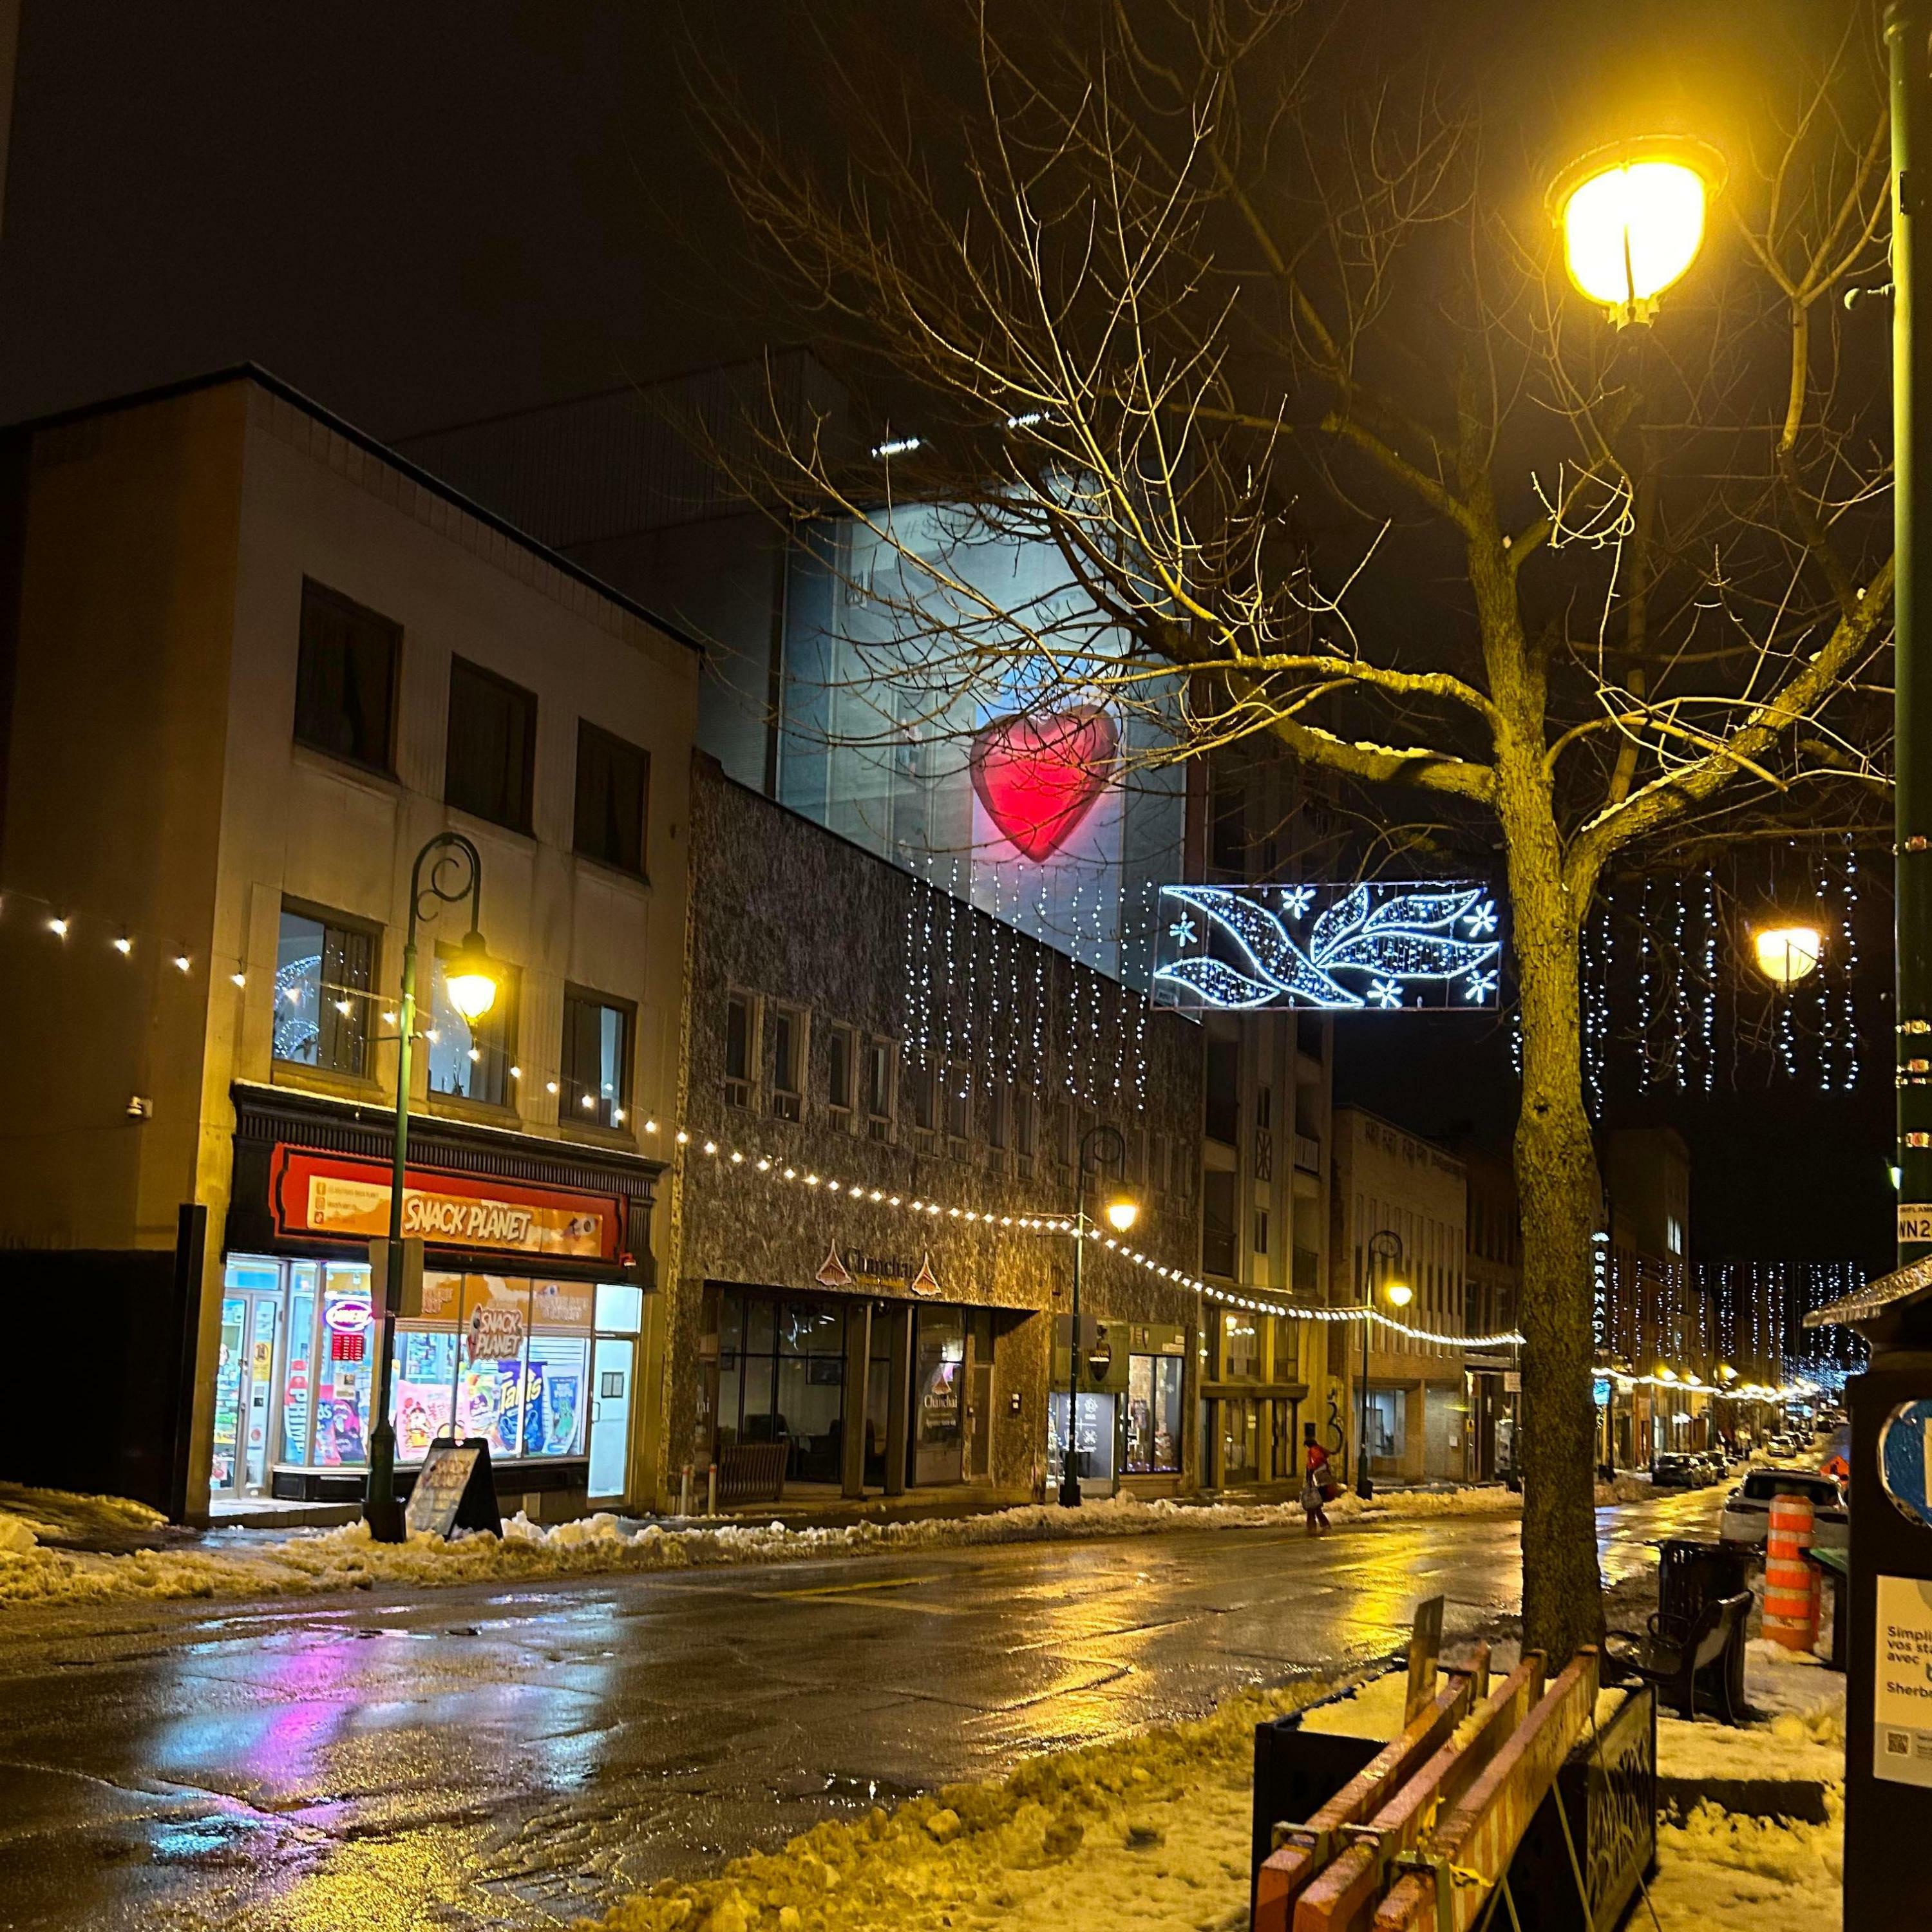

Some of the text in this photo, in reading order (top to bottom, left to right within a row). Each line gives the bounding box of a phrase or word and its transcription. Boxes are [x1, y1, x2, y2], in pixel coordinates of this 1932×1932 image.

[405, 1198, 531, 1241] SNACK PLANET
[481, 1309, 520, 1334] SNACK
[477, 1333, 520, 1357] PLANET
[1887, 1640, 1912, 1652] vos
[1886, 1652, 1920, 1665] avec
